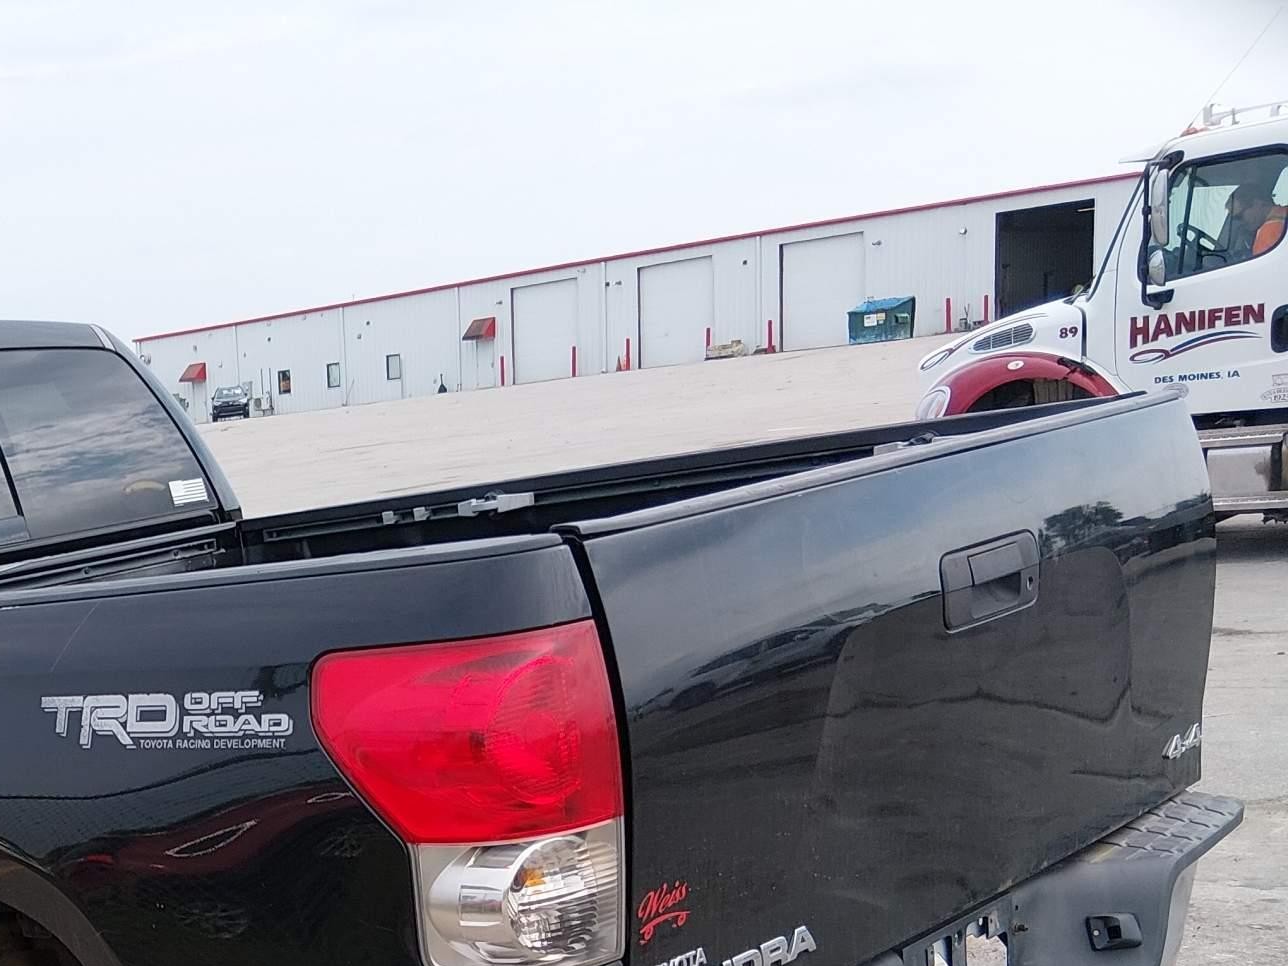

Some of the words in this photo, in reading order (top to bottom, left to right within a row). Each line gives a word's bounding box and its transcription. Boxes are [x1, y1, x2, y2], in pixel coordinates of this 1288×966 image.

[1059, 326, 1078, 339] 89
[1129, 303, 1265, 349] HANIFEN
[1154, 376, 1174, 384] DES
[1227, 370, 1240, 378] IA
[41, 694, 179, 749] TRD
[183, 690, 264, 713] OFF
[183, 713, 294, 736] ROAD
[140, 739, 173, 749] TOYOTA
[176, 739, 210, 749] RACING
[213, 739, 286, 749] DEVELOPMENT
